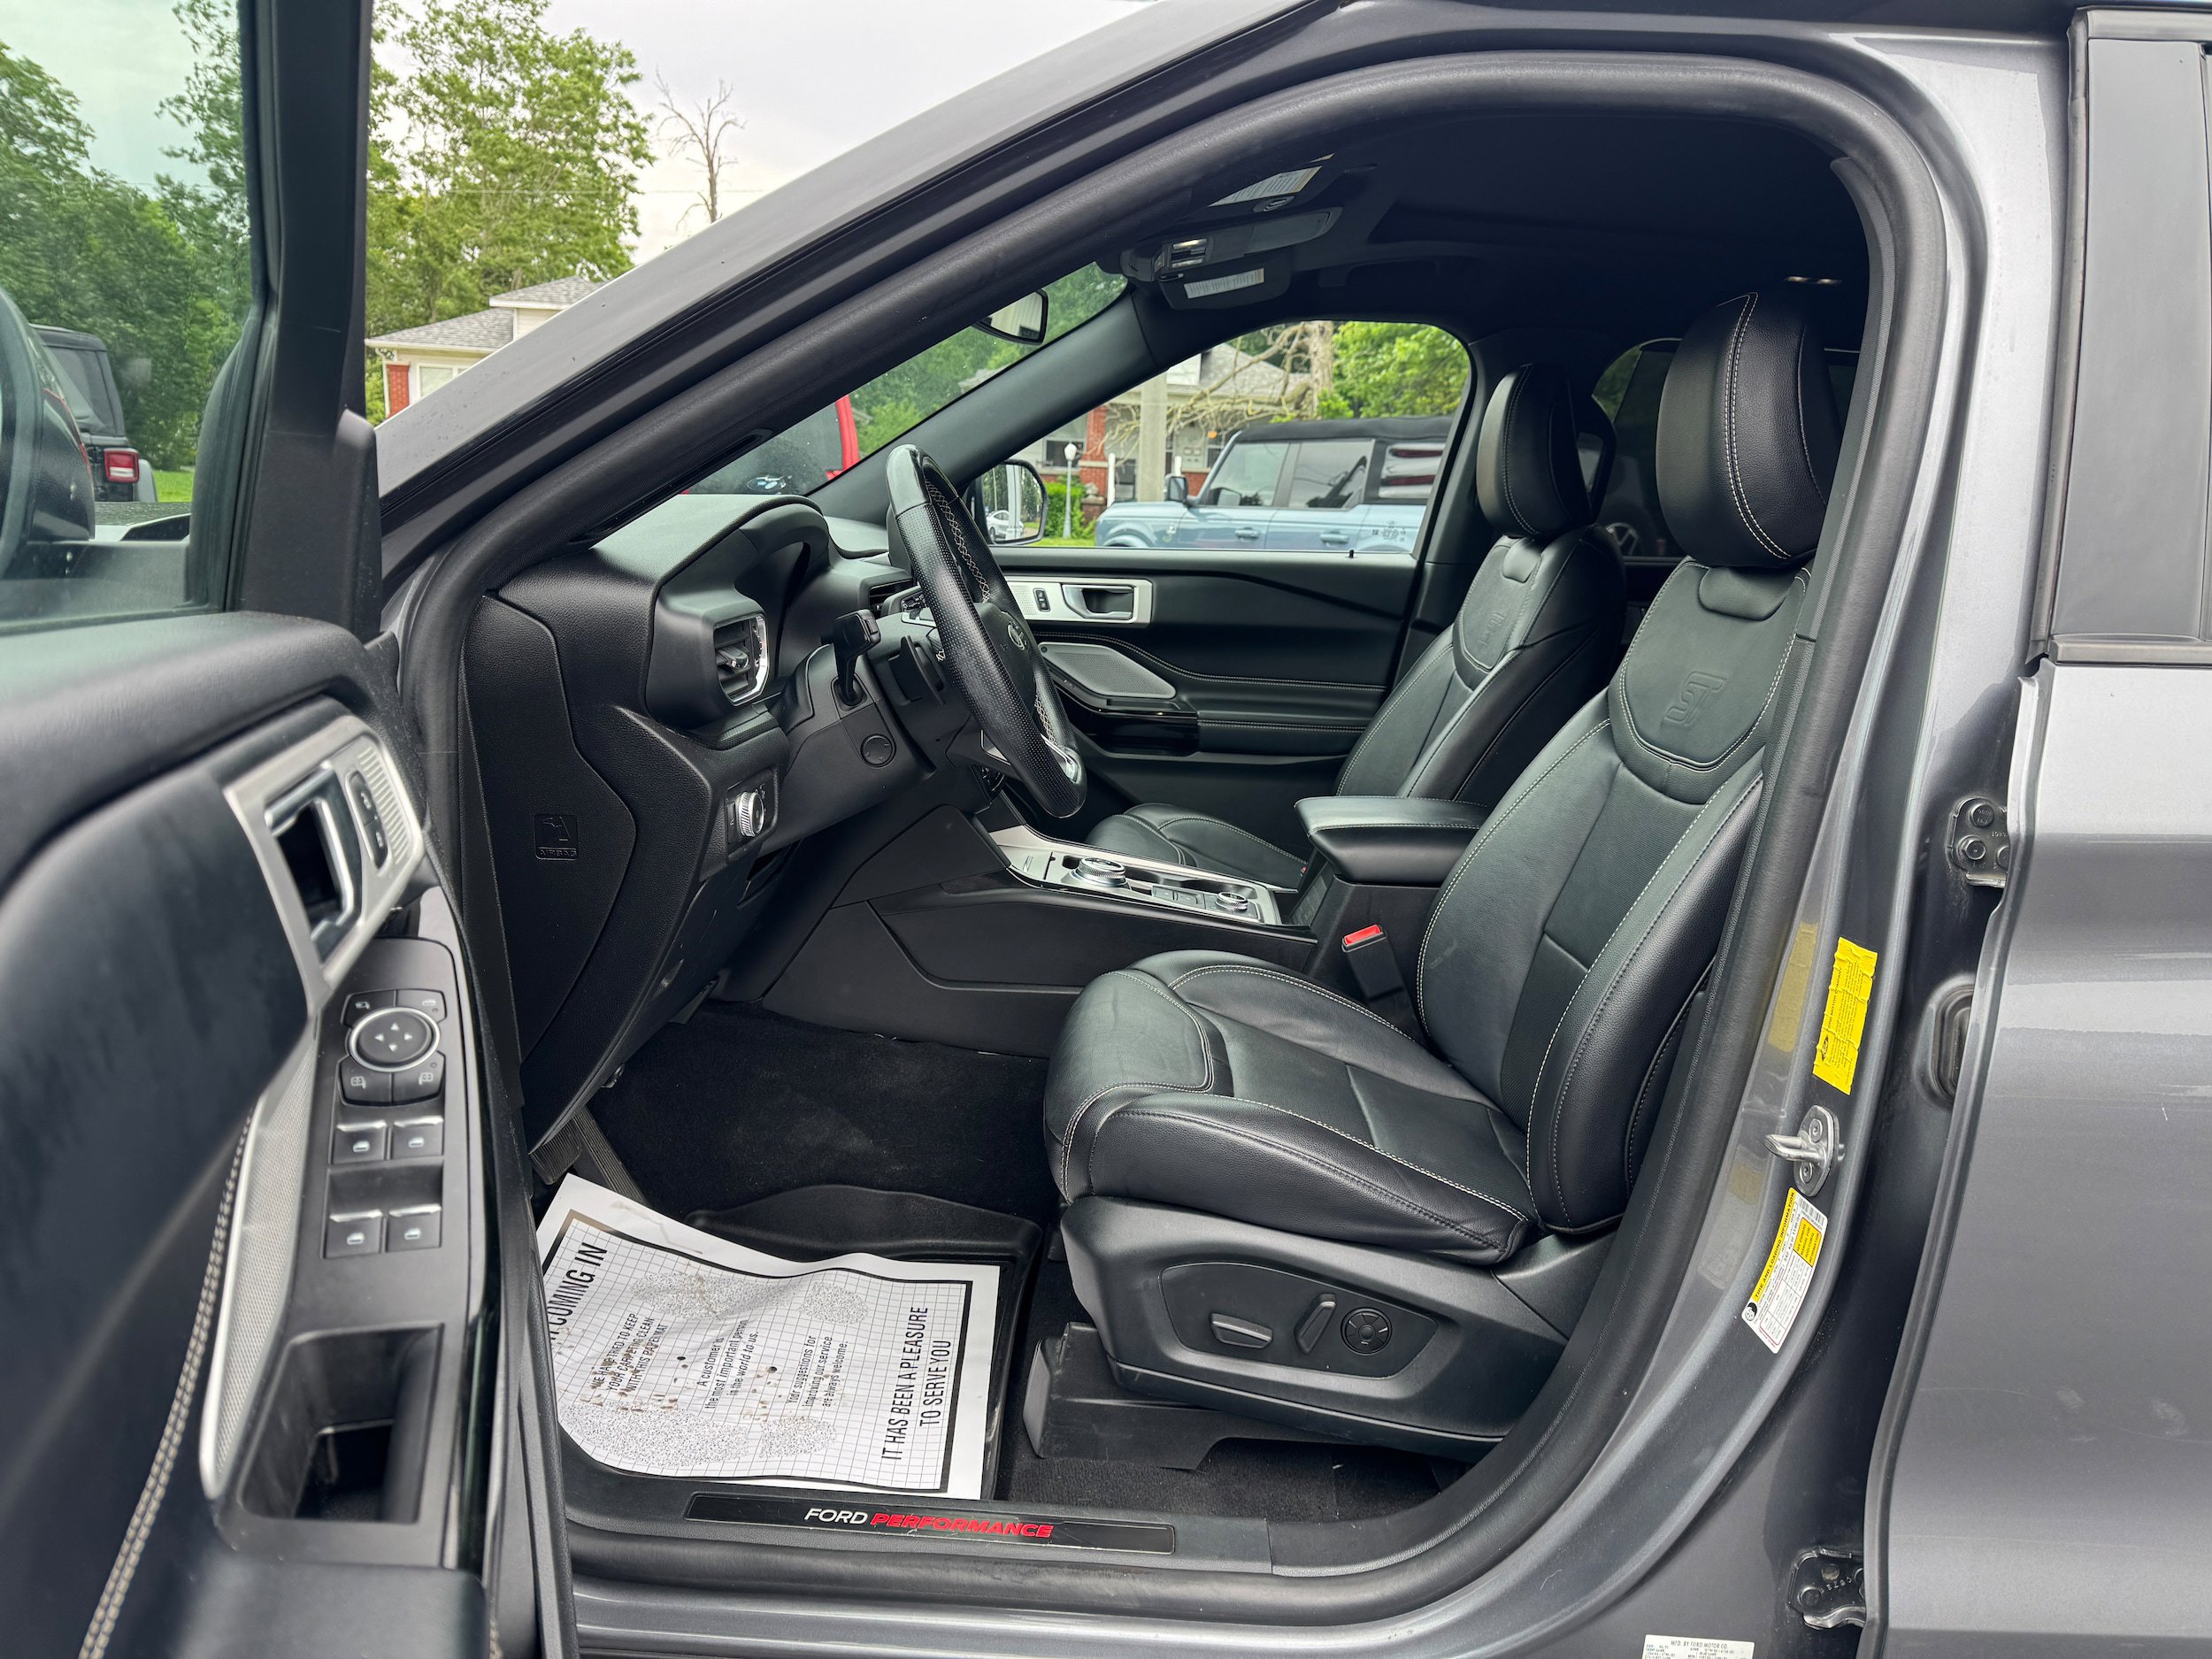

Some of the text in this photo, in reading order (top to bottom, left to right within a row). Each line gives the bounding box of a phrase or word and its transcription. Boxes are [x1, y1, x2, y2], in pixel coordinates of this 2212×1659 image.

[548, 1242, 607, 1325] COMING IN
[1755, 1284, 1764, 1298] TIRE
[1769, 1239, 1782, 1268] LOADING
[617, 1332, 630, 1340] TO
[623, 1313, 638, 1332] KEEP
[749, 1332, 759, 1343] us.
[606, 1371, 626, 1391] YOUR
[636, 1317, 655, 1338] CLEAN
[636, 1356, 650, 1372] THIS
[701, 1344, 721, 1379] customer
[717, 1340, 740, 1378] important
[737, 1353, 751, 1376] world
[743, 1344, 754, 1353] to
[730, 1378, 743, 1388] the
[786, 1335, 817, 1403] Your suggestions for
[803, 1336, 833, 1407] improving our service
[824, 1375, 841, 1396] always
[833, 1340, 849, 1373] welcome.
[881, 1307, 928, 1460] IT HAS BEEN A PLEASURE
[920, 1340, 951, 1426] TO SERVE YOU
[704, 1397, 718, 1409] the
[712, 1379, 726, 1396] most
[804, 1508, 1054, 1538] FORD PERFORMANCE
